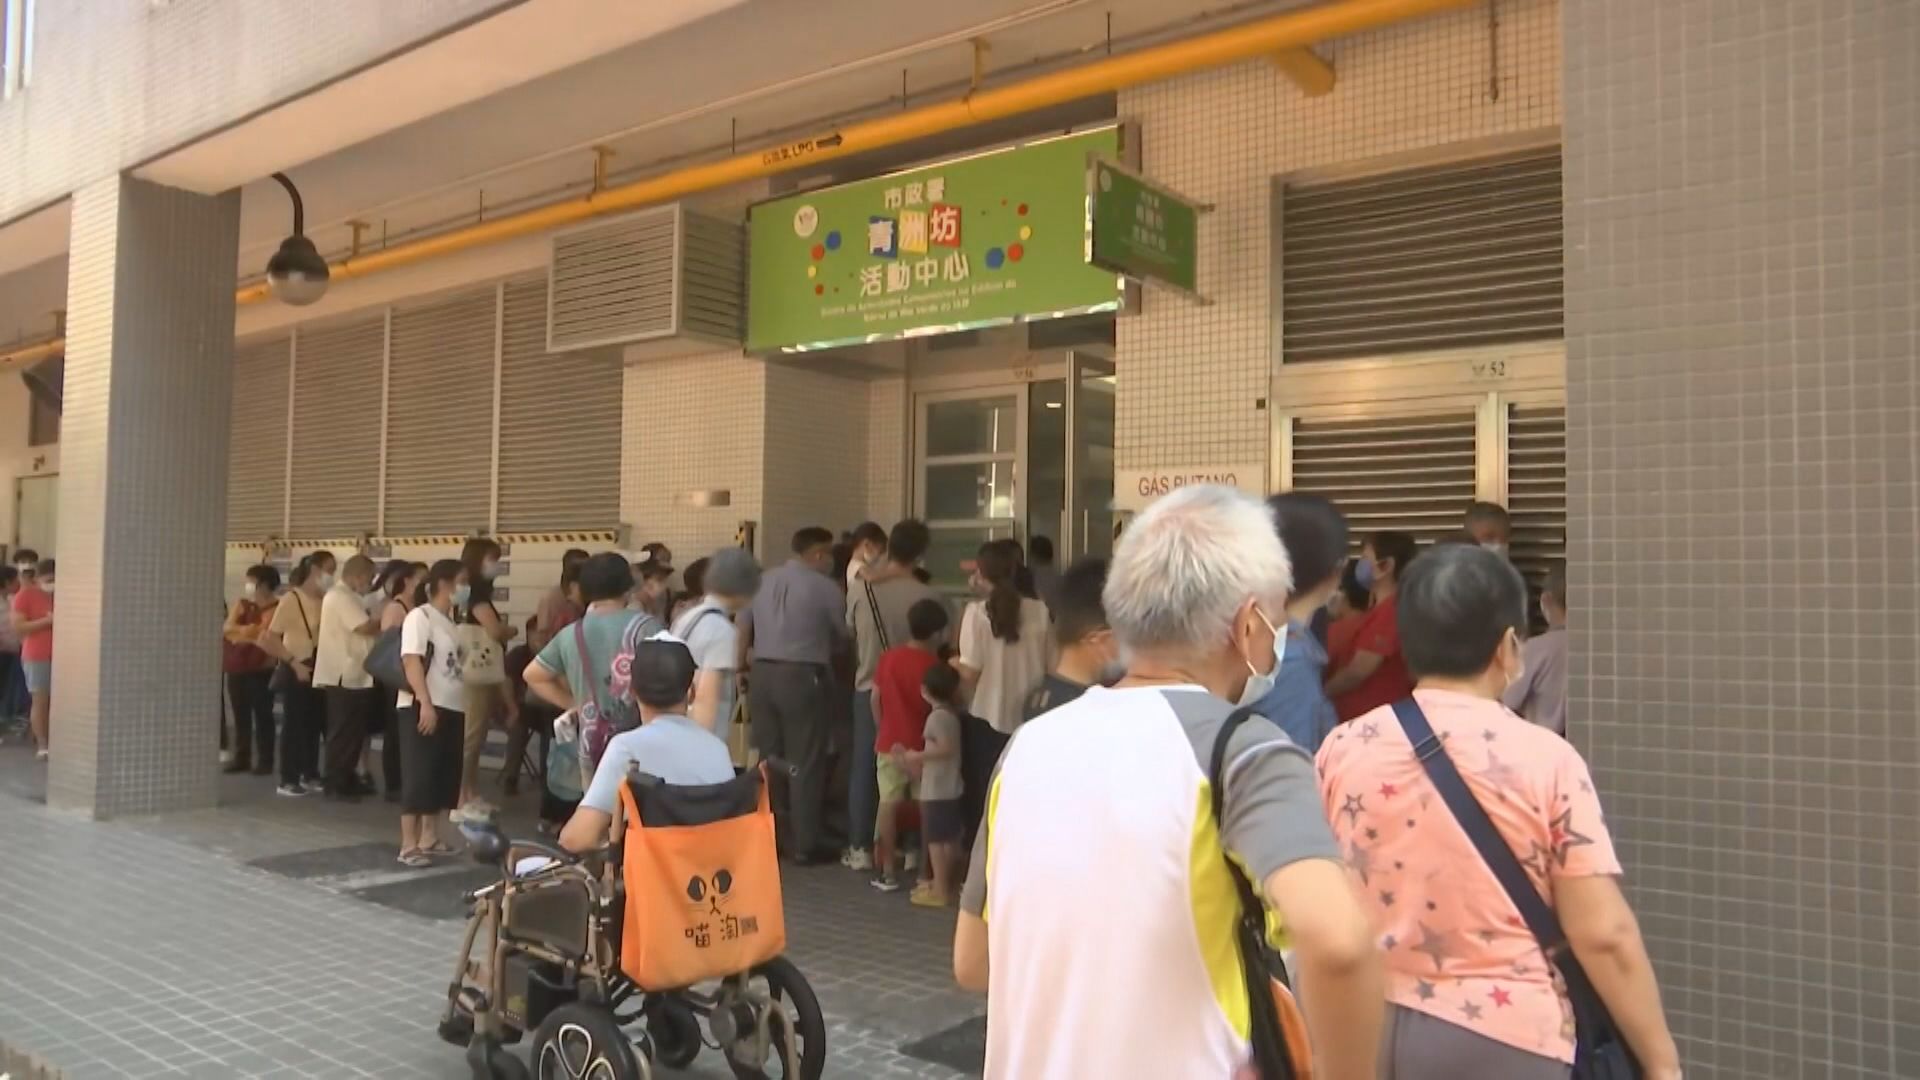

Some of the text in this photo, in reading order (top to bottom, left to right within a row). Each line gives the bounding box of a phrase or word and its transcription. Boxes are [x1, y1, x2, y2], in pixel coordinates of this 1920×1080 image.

[792, 140, 815, 157] LPG
[859, 250, 970, 298] 活動中心
[1138, 472, 1169, 497] GÁS
